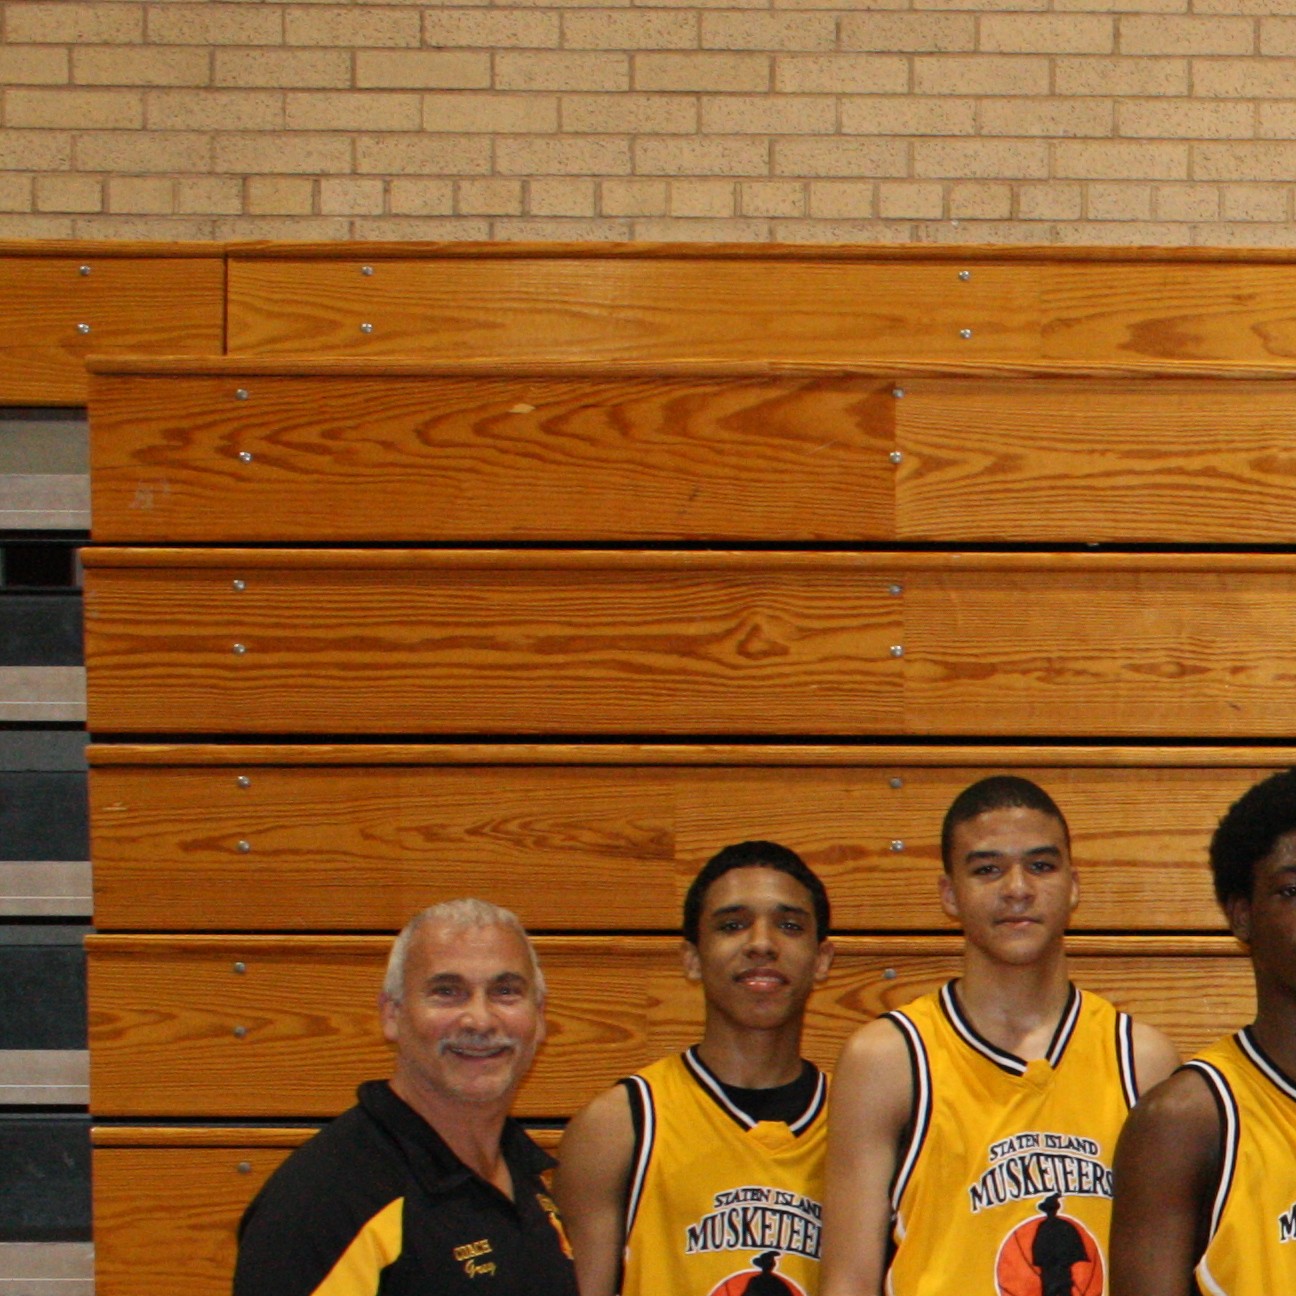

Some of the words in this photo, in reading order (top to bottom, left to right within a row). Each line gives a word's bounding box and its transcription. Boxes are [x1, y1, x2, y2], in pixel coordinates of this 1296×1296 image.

[989, 1134, 1040, 1161] STATEN
[1045, 1134, 1098, 1155] ISLAND
[714, 1188, 771, 1208] STATEN
